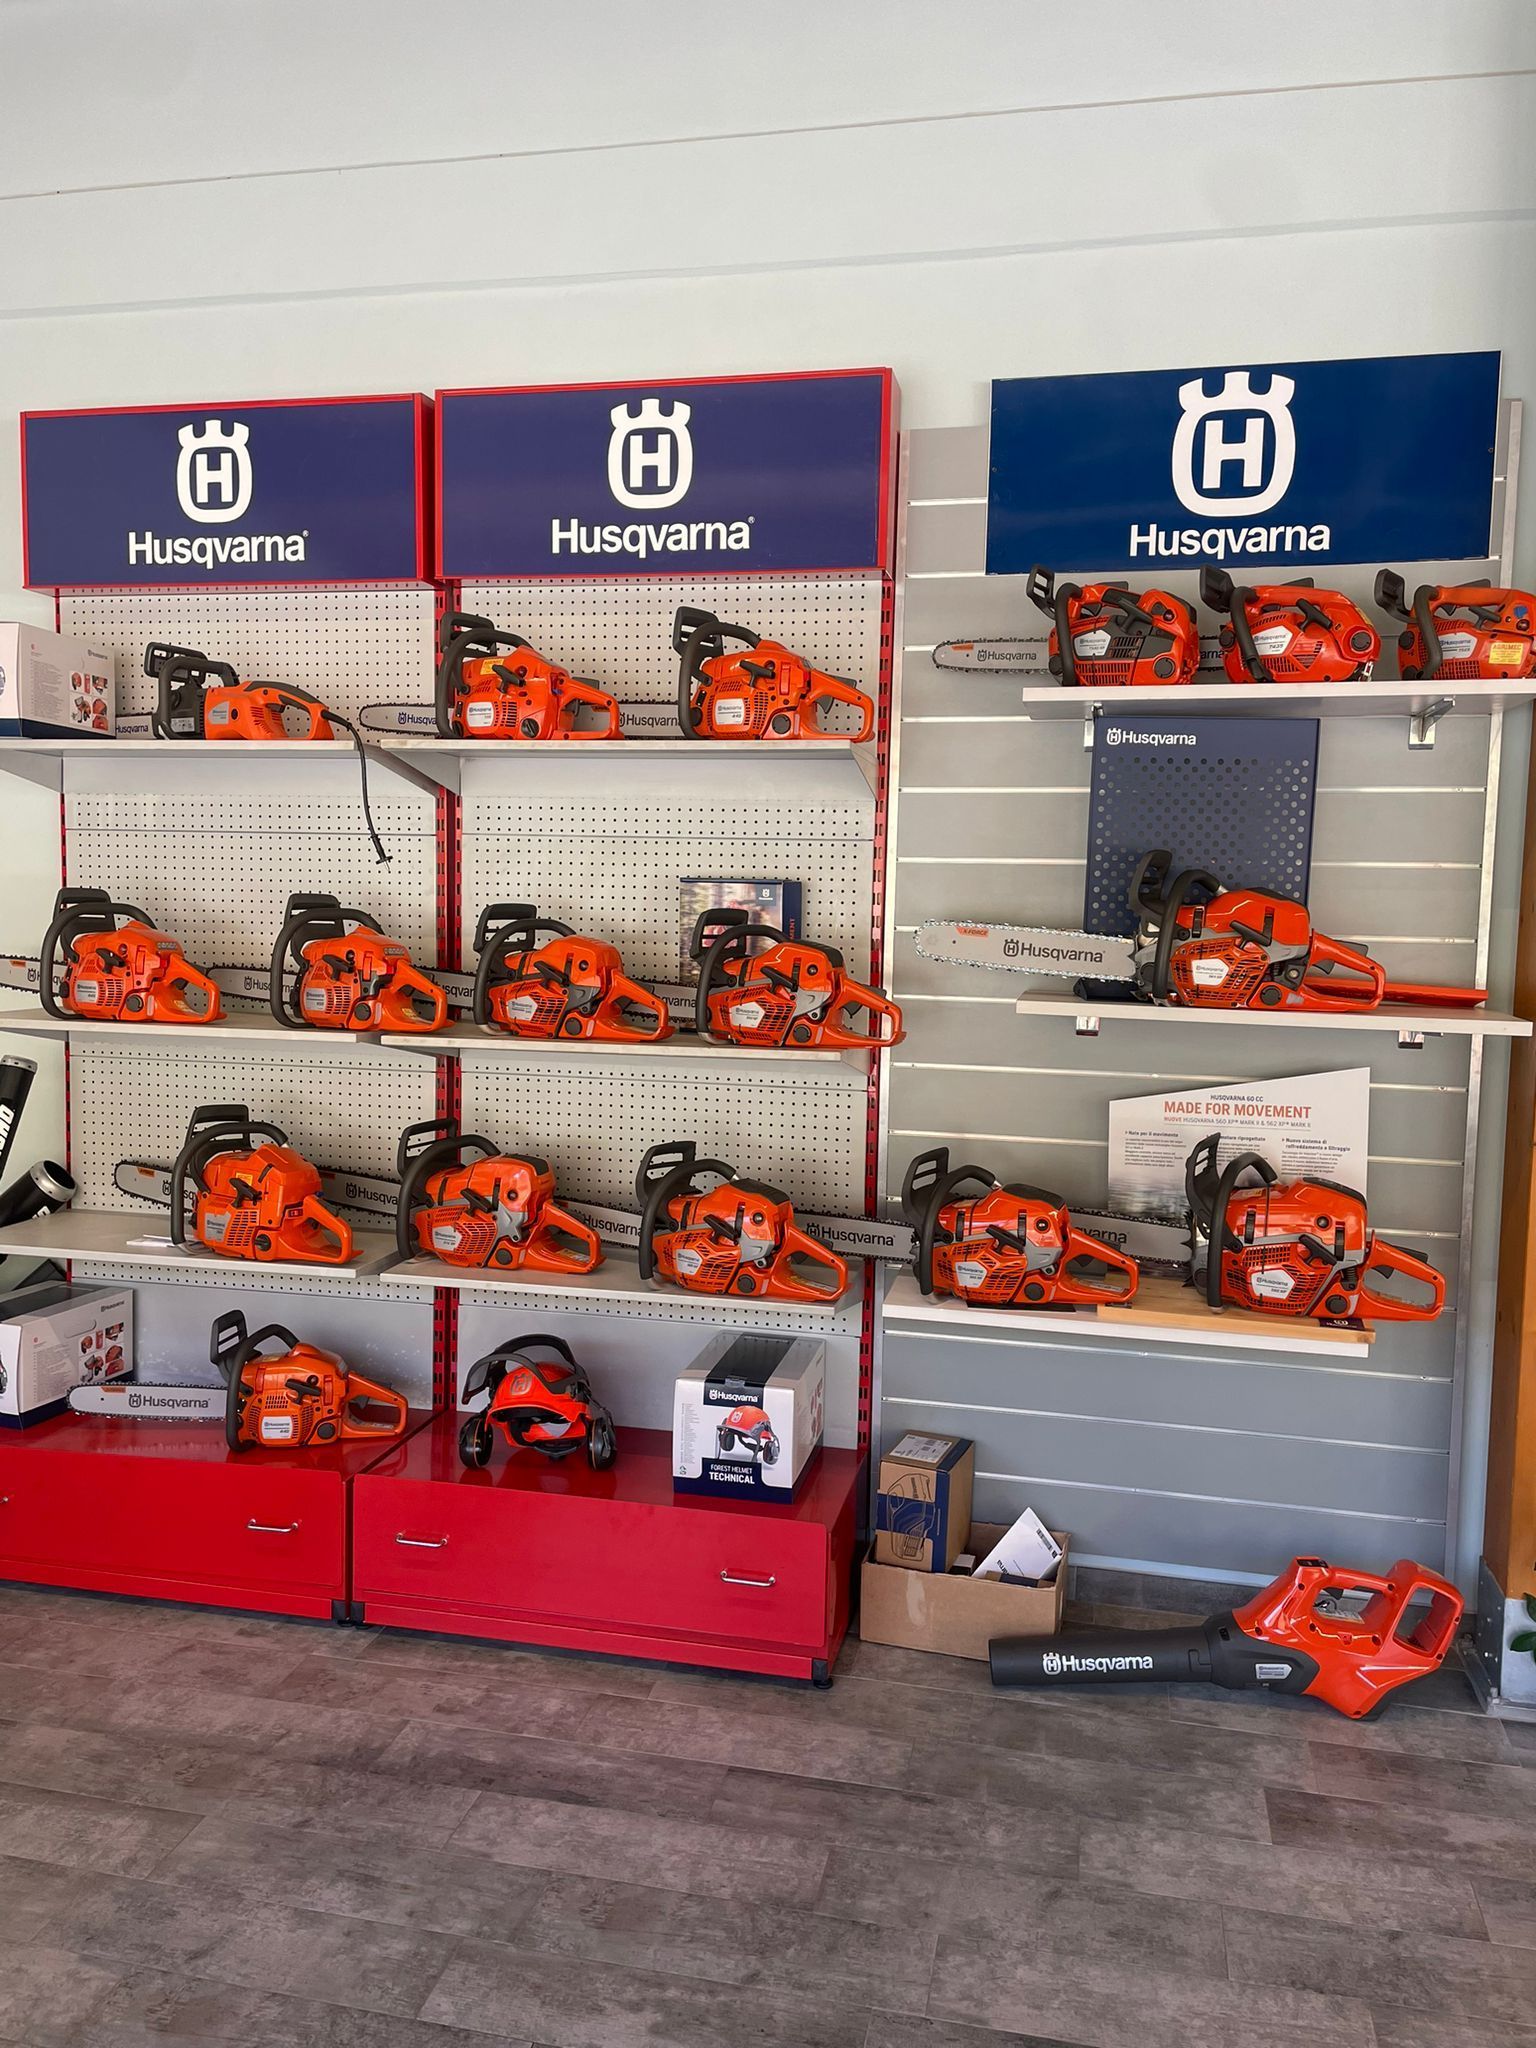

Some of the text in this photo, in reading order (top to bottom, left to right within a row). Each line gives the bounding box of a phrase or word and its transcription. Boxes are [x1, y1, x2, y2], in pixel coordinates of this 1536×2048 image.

[1129, 523, 1330, 560] Husqvarna
[988, 651, 1037, 662] Husqvarna
[1122, 731, 1197, 746] Husqvarna
[1164, 1101, 1312, 1118] MADE FOR MOVEMENT
[822, 1227, 895, 1247] Husqvarna
[143, 1395, 209, 1409] Husqvarna
[718, 1391, 759, 1402] Husqvarna
[711, 1464, 753, 1474] FOREST HELMET
[709, 1472, 755, 1484] TECHNICAL
[1062, 1655, 1154, 1673] Husqvarna
